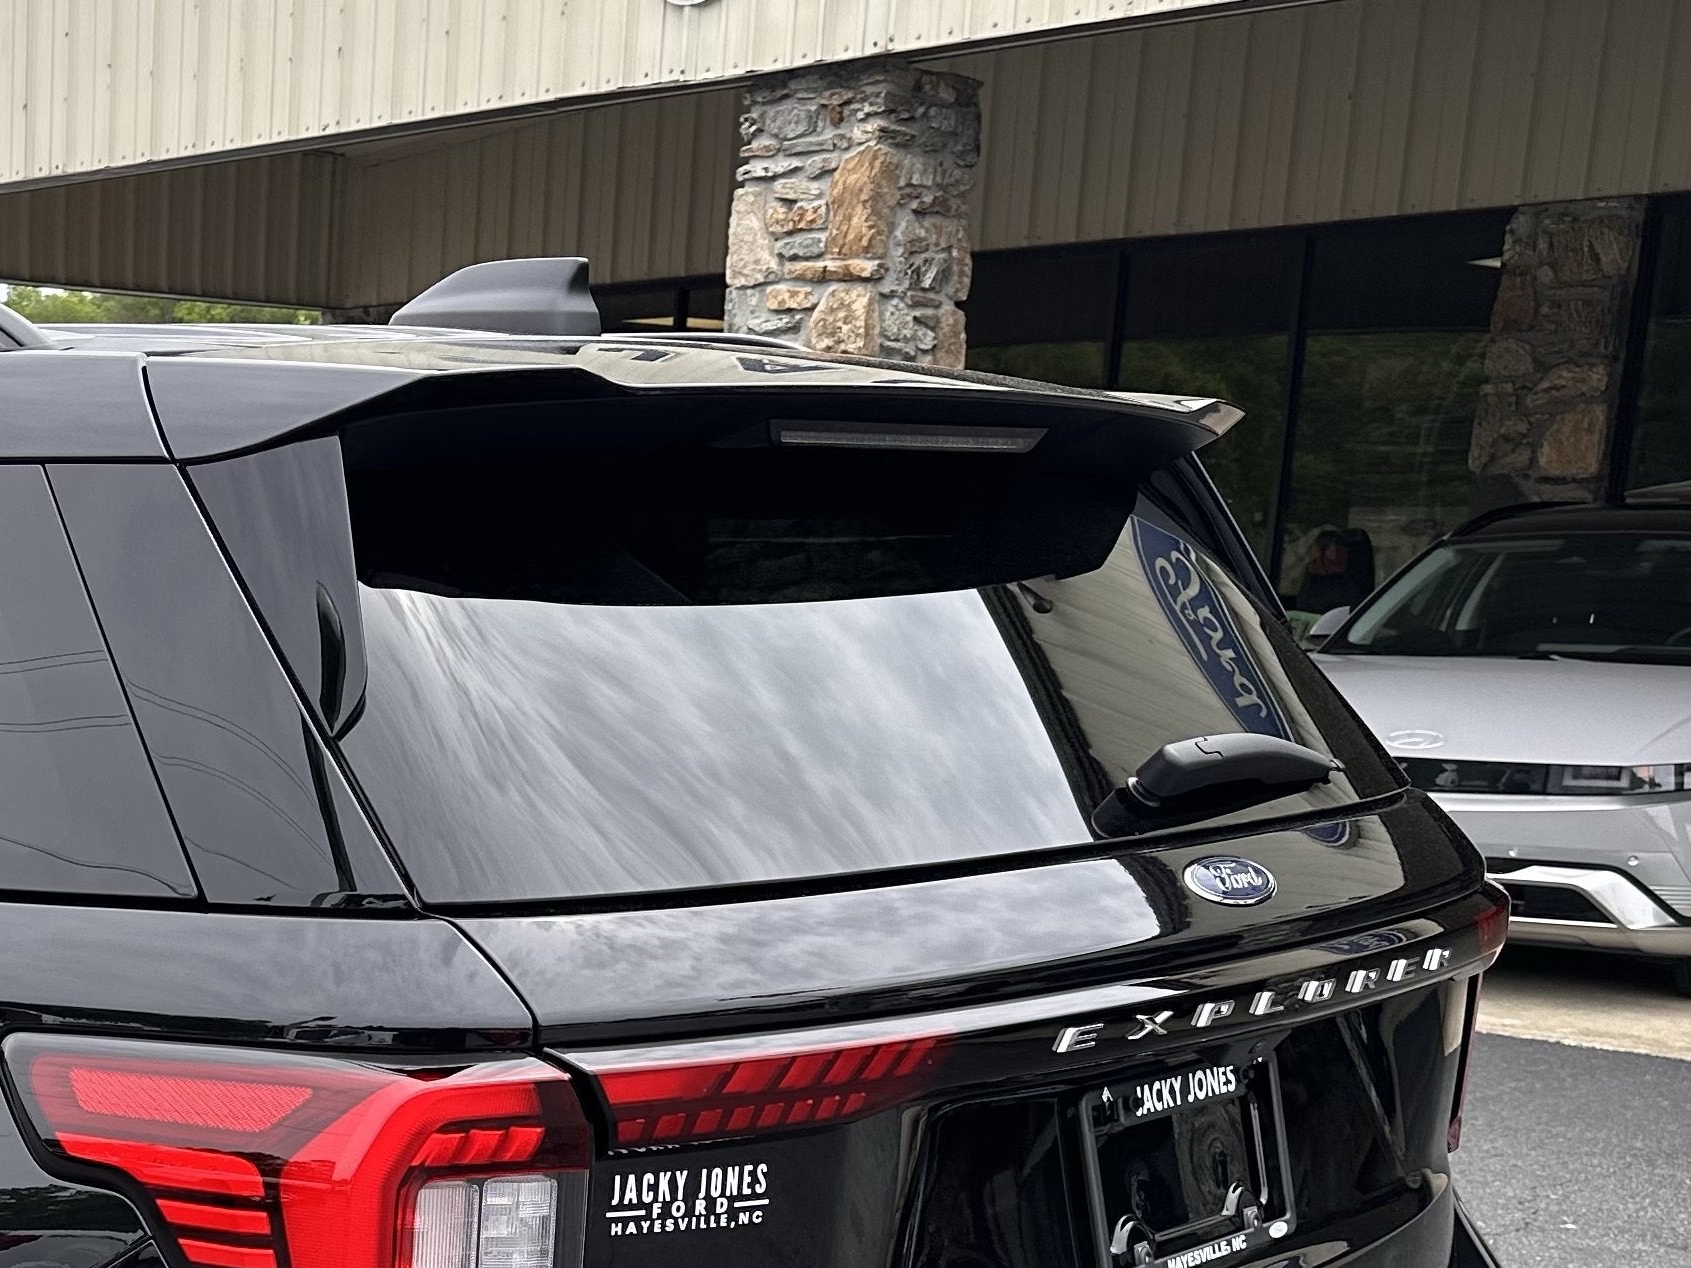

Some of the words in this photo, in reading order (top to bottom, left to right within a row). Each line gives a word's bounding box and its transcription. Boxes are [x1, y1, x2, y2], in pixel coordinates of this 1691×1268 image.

[1208, 861, 1263, 892] Ford
[1052, 947, 1453, 1054] EXPLORER
[1135, 1075, 1182, 1117] JACKY
[1187, 1065, 1237, 1103] JONES
[611, 1169, 689, 1206] JACKY
[699, 1163, 769, 1200] JONES
[651, 1196, 729, 1219] FORD
[1231, 1234, 1247, 1252] NC
